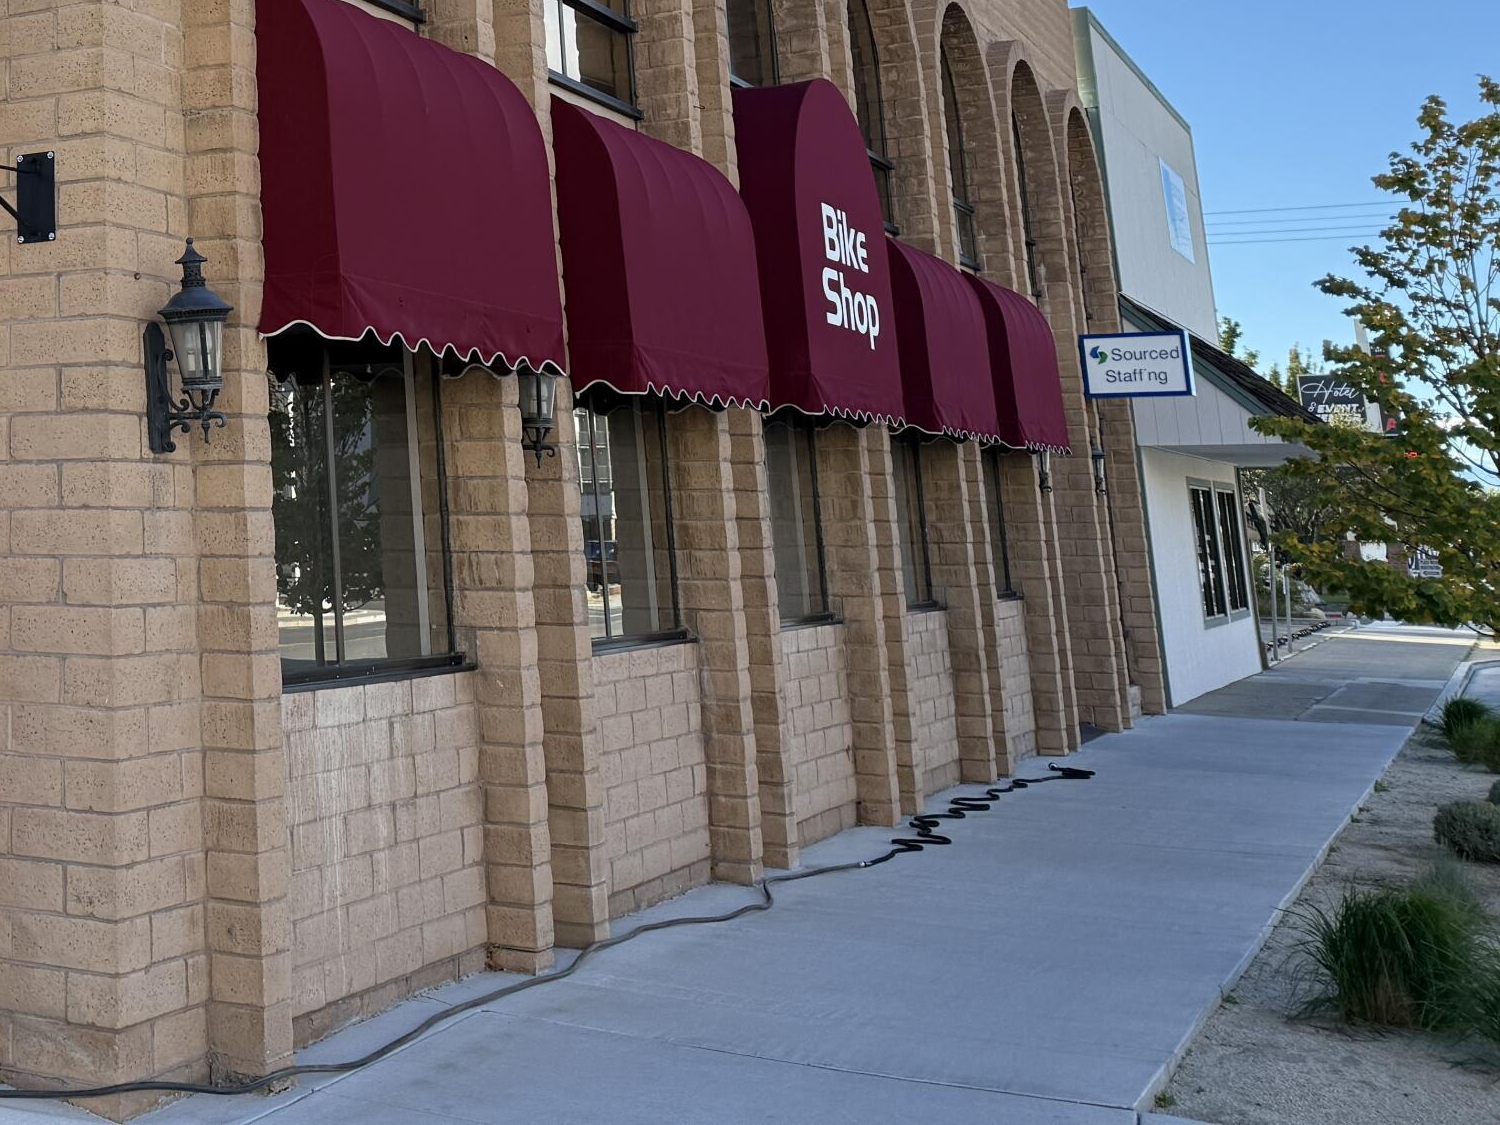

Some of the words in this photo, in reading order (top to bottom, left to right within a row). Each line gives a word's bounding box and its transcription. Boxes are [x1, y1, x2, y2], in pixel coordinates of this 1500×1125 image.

[821, 202, 869, 274] Bike
[822, 266, 880, 351] Shop
[1111, 345, 1180, 362] Sourced
[1105, 368, 1168, 385] Staffng
[1301, 380, 1359, 404] Hotel
